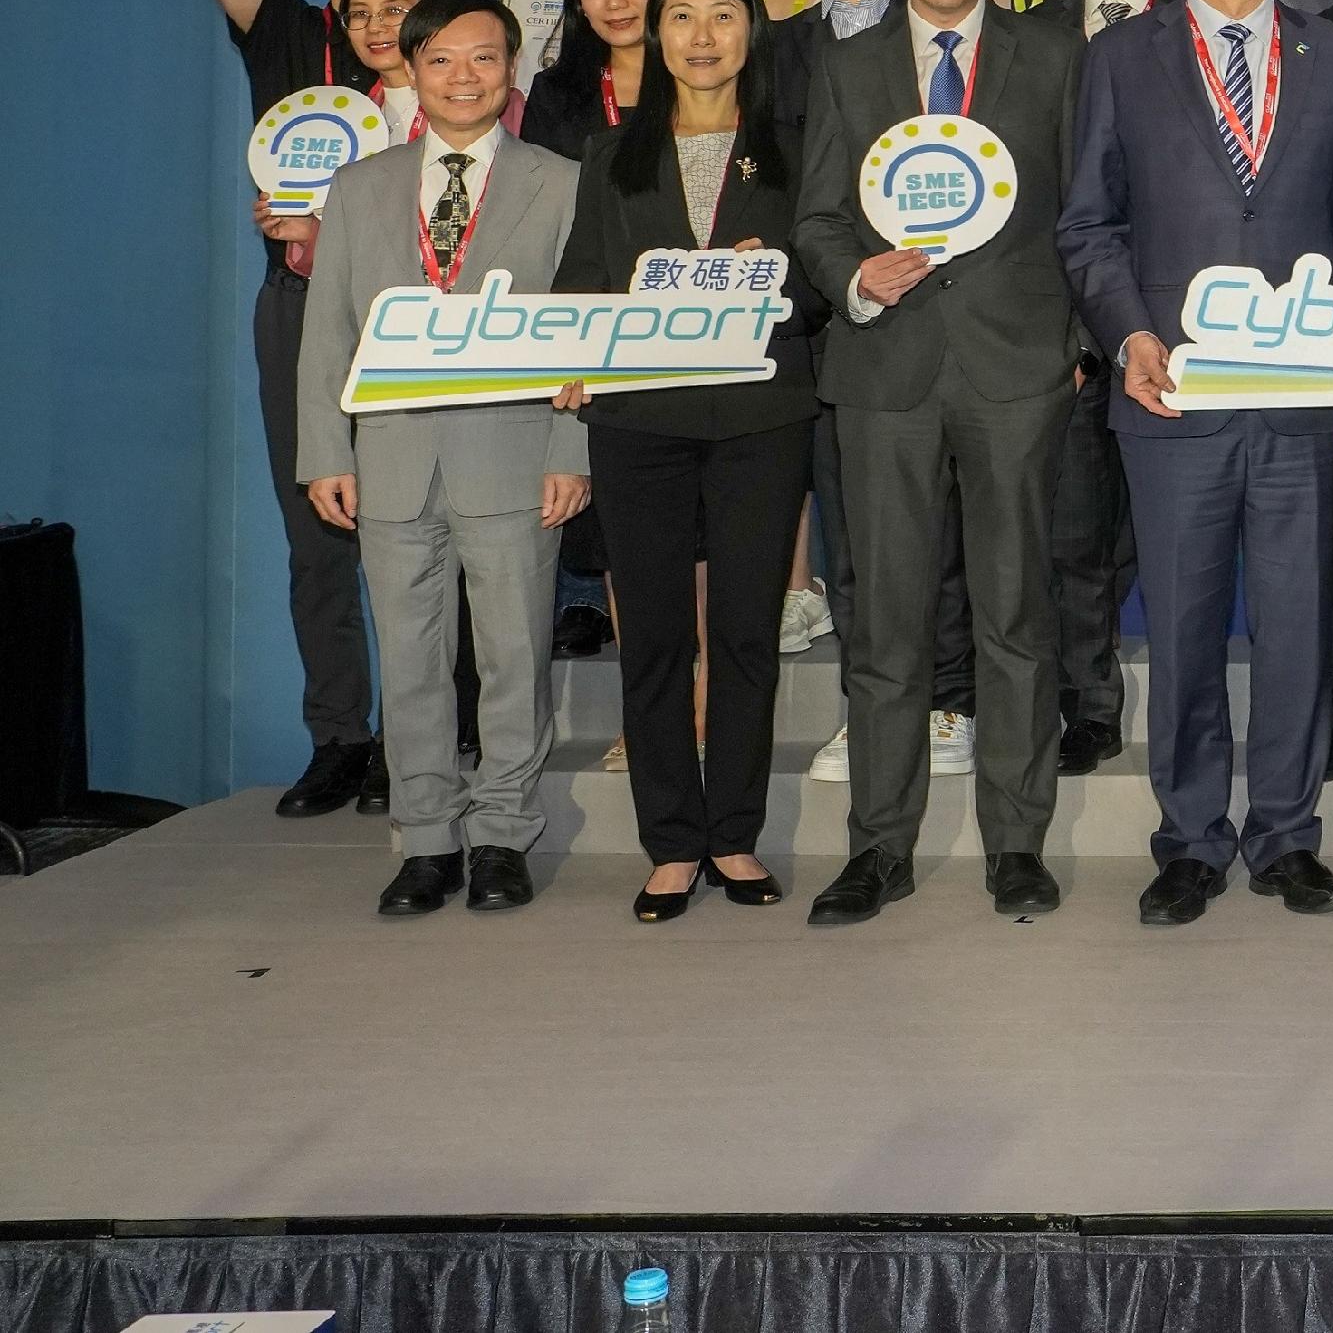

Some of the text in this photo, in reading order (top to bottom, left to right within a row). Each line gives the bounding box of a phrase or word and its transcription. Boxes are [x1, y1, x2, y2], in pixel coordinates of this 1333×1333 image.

[291, 137, 343, 153] SME
[278, 153, 340, 170] IEGC
[906, 173, 965, 190] SME
[898, 191, 967, 211] IEGC
[638, 258, 779, 292] 數碼港
[373, 278, 784, 367] Cyberport
